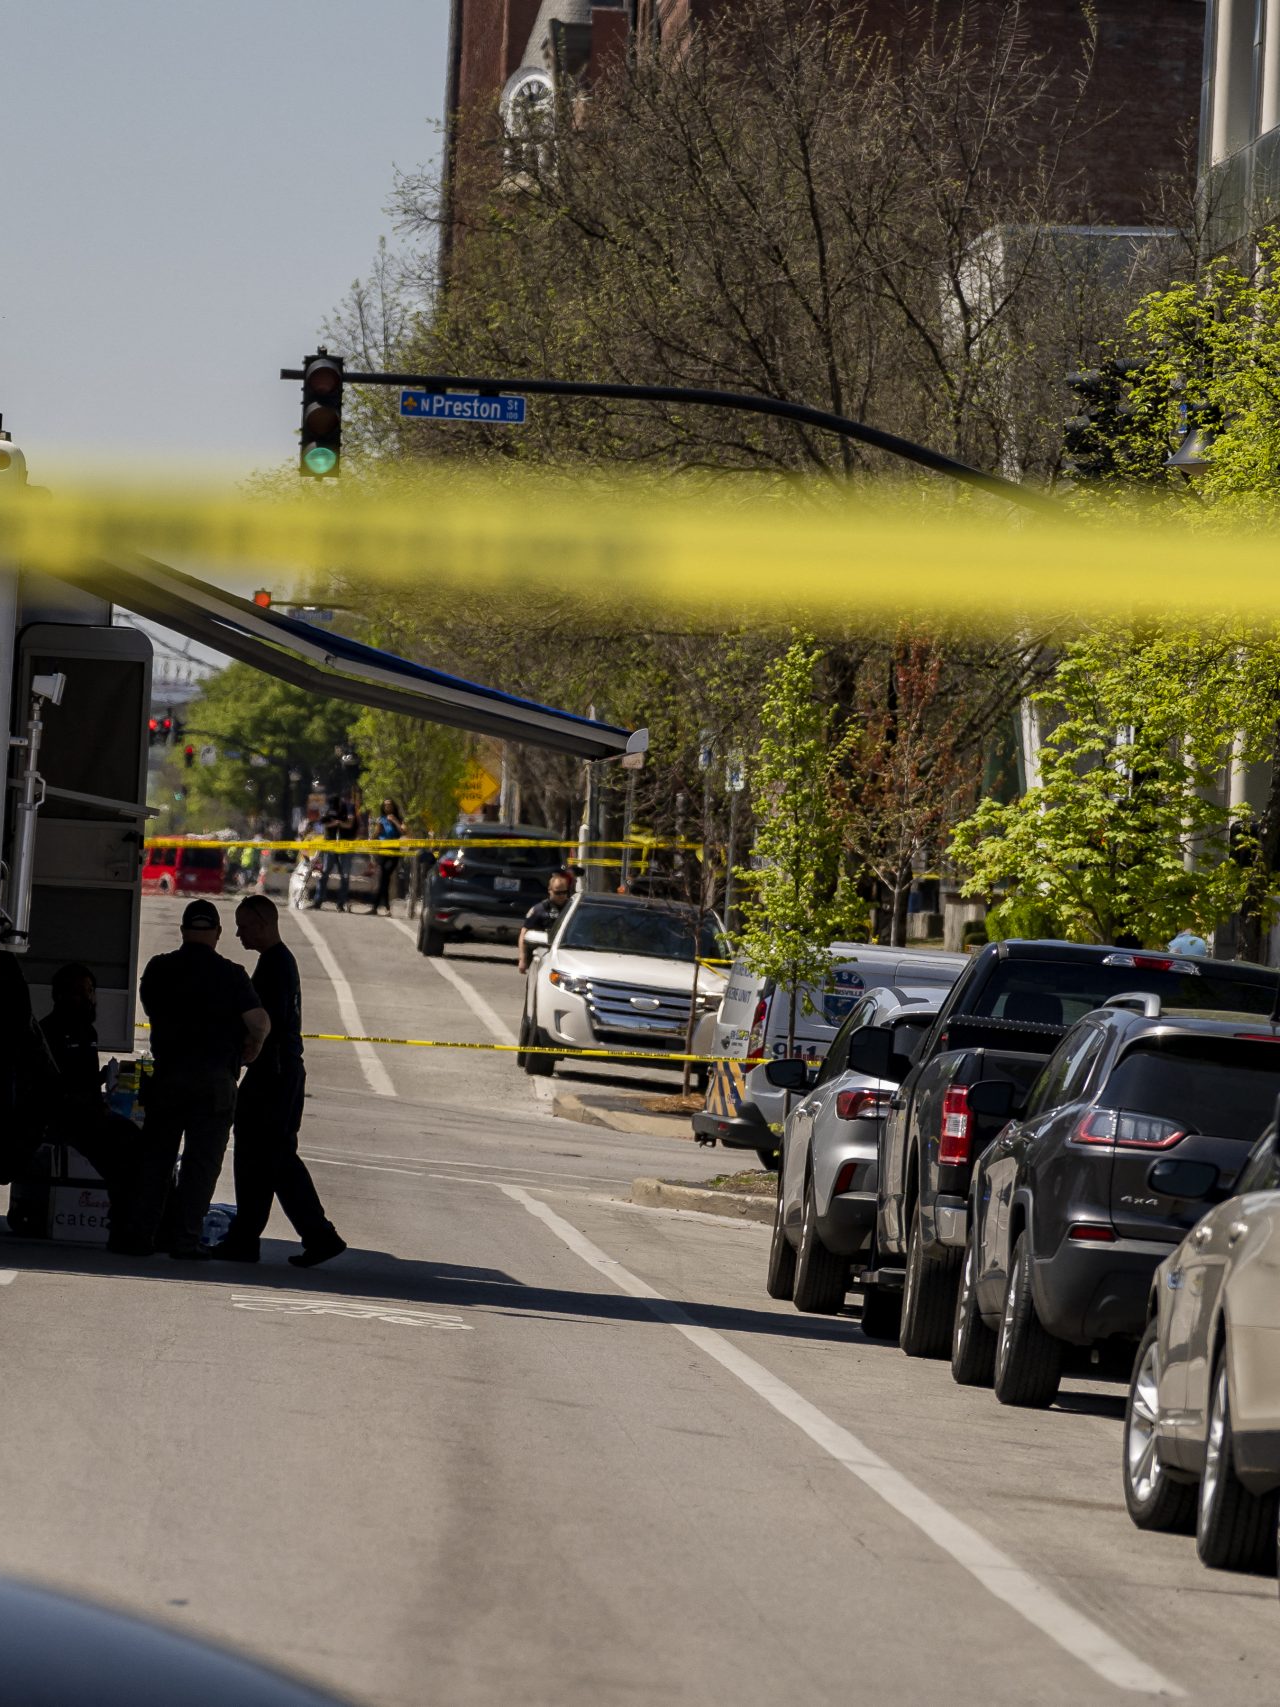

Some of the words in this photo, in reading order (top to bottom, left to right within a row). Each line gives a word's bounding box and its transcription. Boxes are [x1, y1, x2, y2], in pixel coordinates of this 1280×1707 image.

[421, 398, 429, 412] N
[433, 395, 500, 418] Preston
[507, 399, 518, 411] St
[773, 1042, 817, 1060] 911
[1120, 1195, 1158, 1206] 4x4
[55, 1212, 111, 1228] cater
